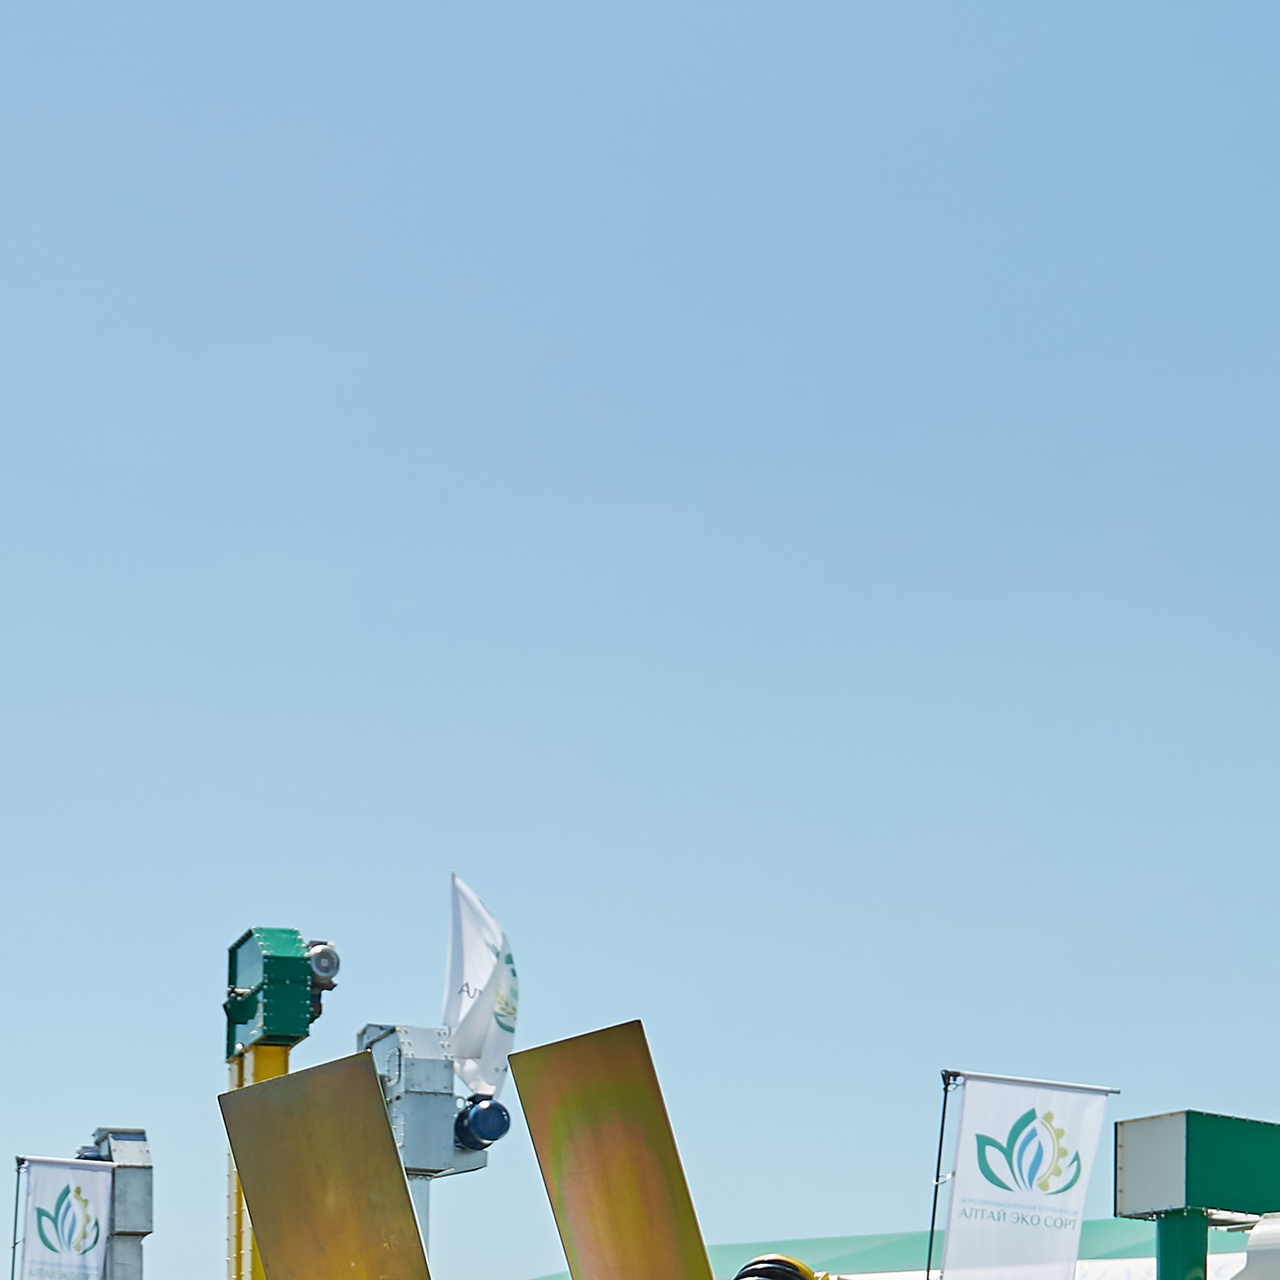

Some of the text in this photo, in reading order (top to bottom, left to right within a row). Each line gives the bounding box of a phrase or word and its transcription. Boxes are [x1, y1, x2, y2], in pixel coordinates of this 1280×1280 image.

[959, 1207, 1077, 1231] АЛТАЙ ЭКО СОРТ
